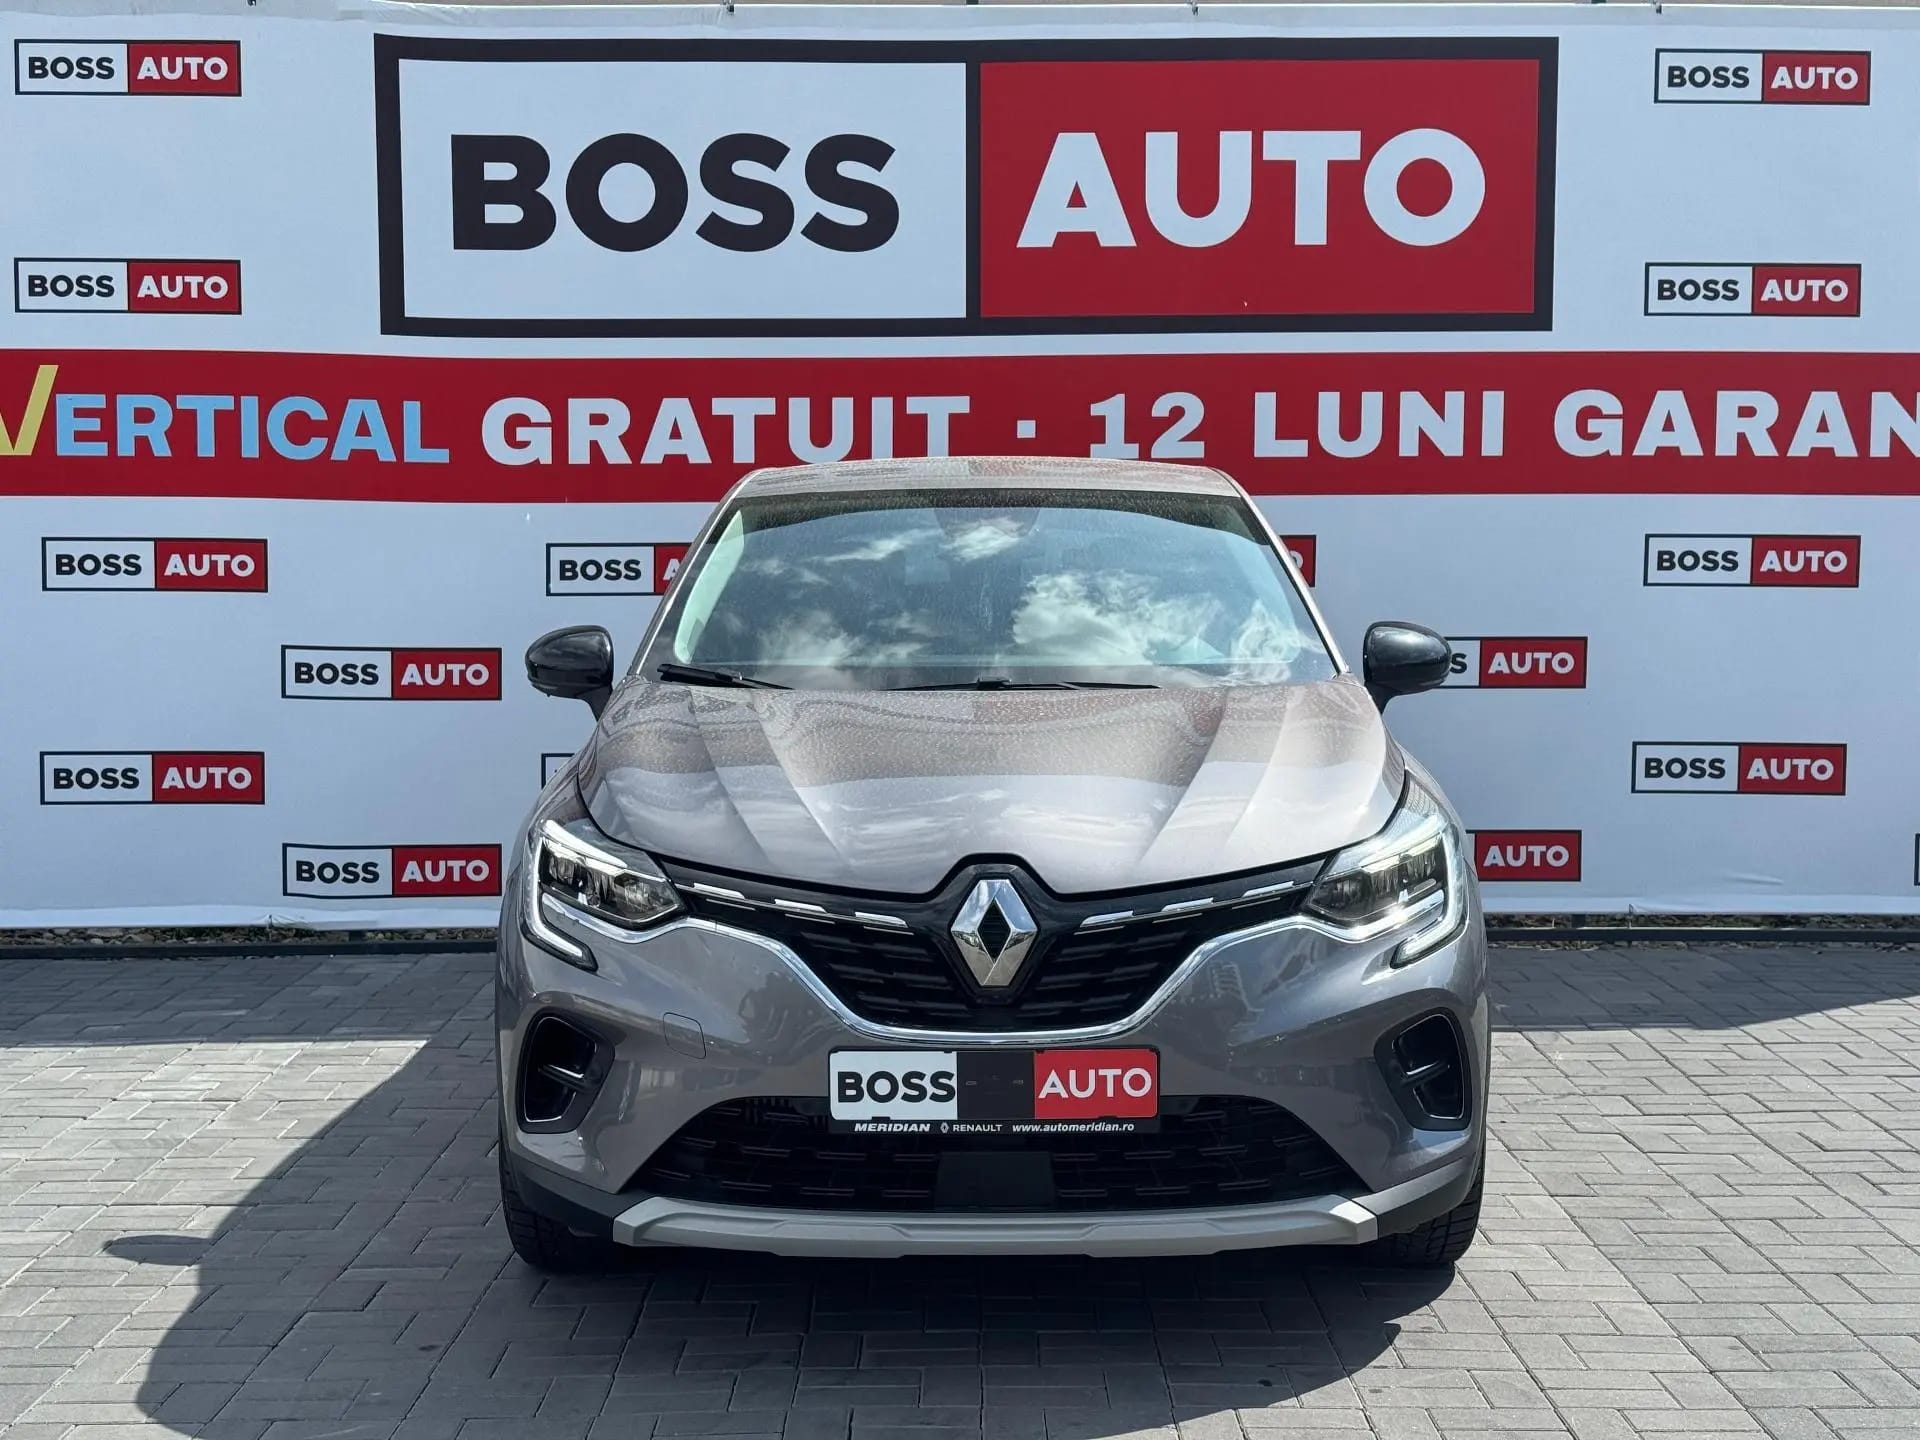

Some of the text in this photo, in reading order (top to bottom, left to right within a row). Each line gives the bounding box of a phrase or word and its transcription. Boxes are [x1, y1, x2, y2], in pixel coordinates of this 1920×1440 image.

[27, 56, 229, 81] BOSS AUTO
[1667, 65, 1859, 90] BOSS AUTO
[451, 127, 1486, 253] BOSS AUTO
[27, 274, 229, 299] BOSS AUTO
[1656, 279, 1849, 302] BOSS AUTO
[481, 394, 970, 466] GRATUIT
[1090, 392, 1206, 459] 12
[1253, 390, 1505, 459] LUNI
[54, 553, 256, 577] BOSS AUTO
[558, 559, 642, 581] BOSS
[1656, 549, 1848, 573] BOSS AUTO
[293, 662, 490, 686] BOSS AUTO
[1487, 652, 1575, 674] AUTO
[52, 766, 252, 790] BOSS AUTO
[1644, 757, 1834, 781] BOSS AUTO
[1483, 845, 1569, 868] AUTO
[295, 860, 490, 884] BOSS AUTO
[837, 1068, 1152, 1103] BOSS AUTO
[854, 1122, 1135, 1133] MERIDIAN RENAULT www.automeridian.ro
